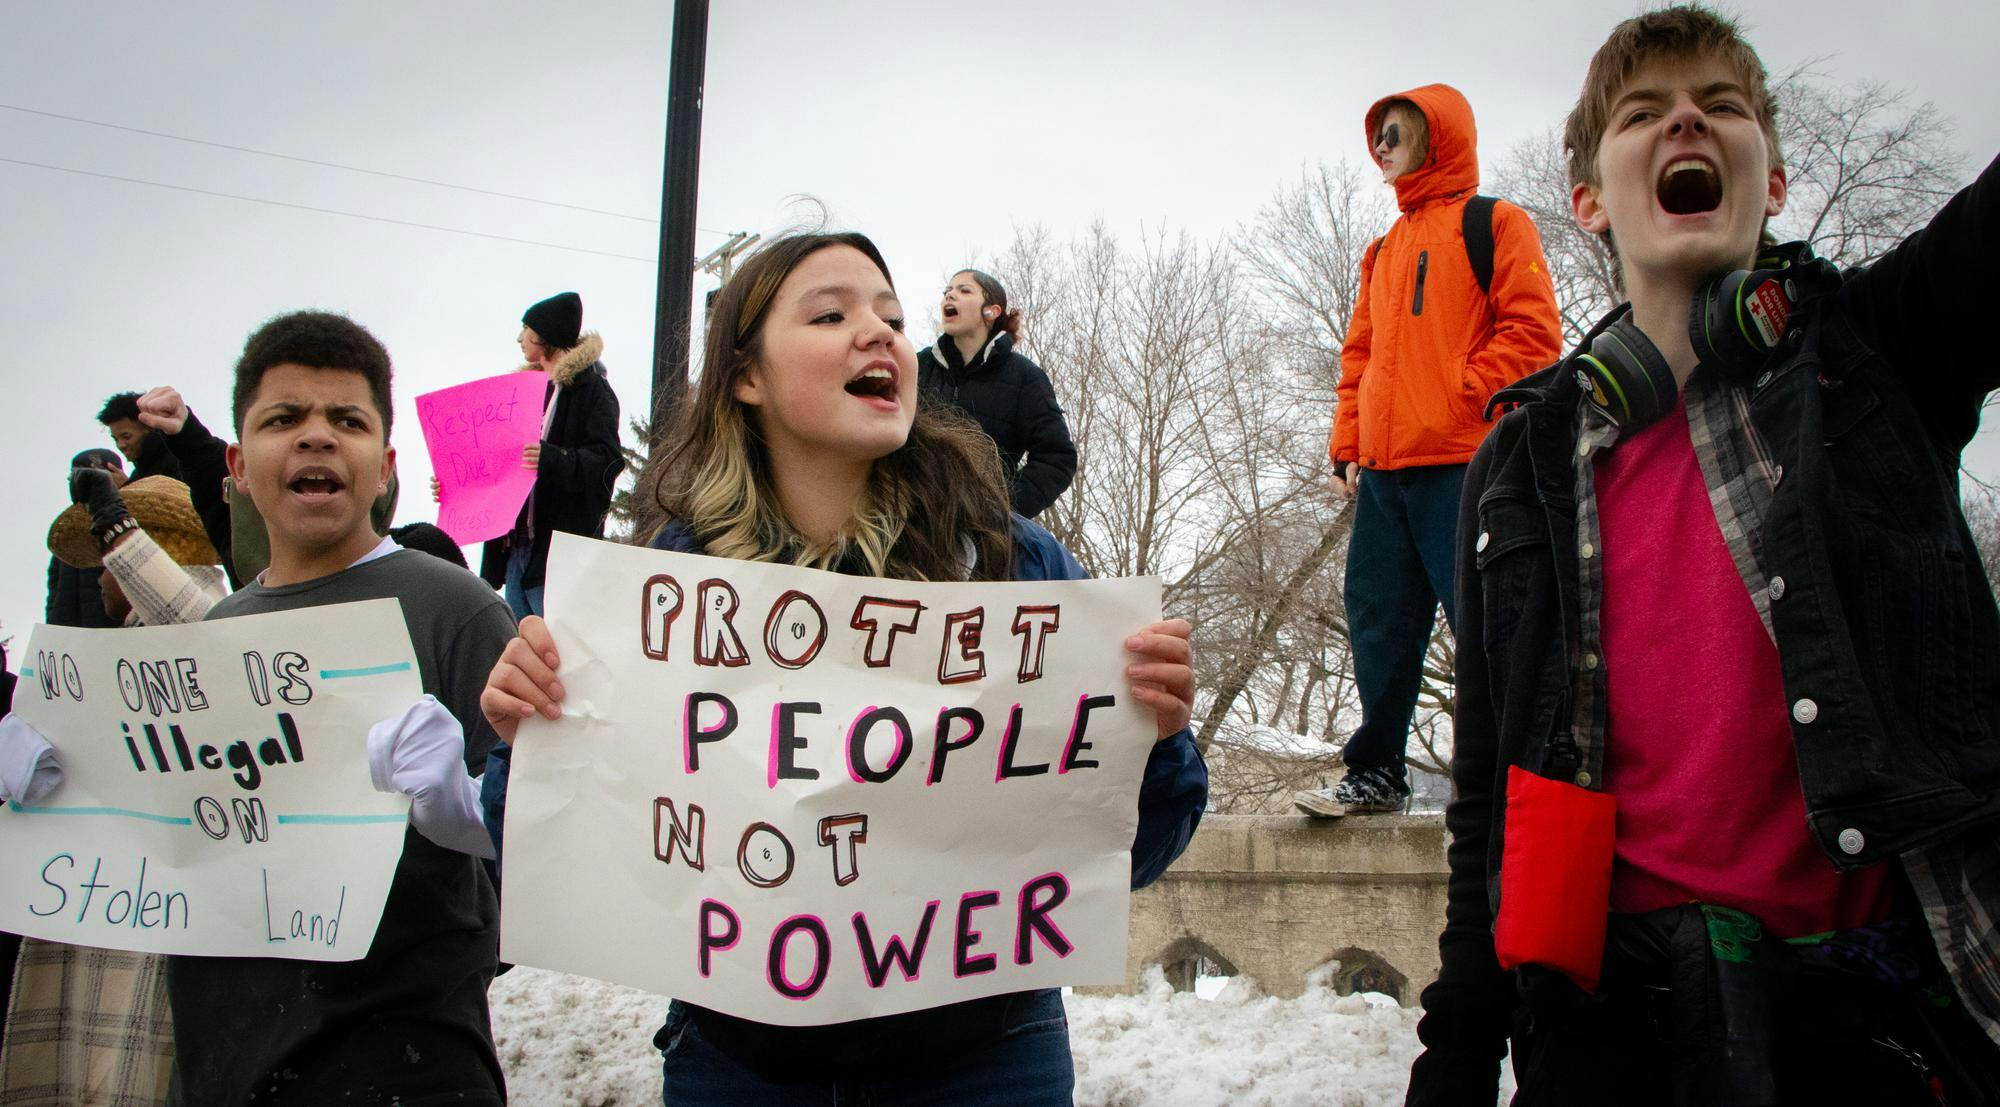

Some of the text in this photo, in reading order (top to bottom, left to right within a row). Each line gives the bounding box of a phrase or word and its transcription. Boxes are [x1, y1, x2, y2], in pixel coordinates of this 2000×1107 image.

[424, 387, 518, 448] Respect
[451, 453, 489, 487] Due
[642, 575, 1059, 683] PROTET
[38, 651, 313, 716] NO ONE IS
[122, 714, 304, 790] illegal
[683, 692, 1115, 788] PEOPLE
[195, 796, 269, 844] ON
[653, 797, 868, 888] NOT
[29, 855, 346, 948] Stolen Land
[698, 872, 1075, 1000] POWER
